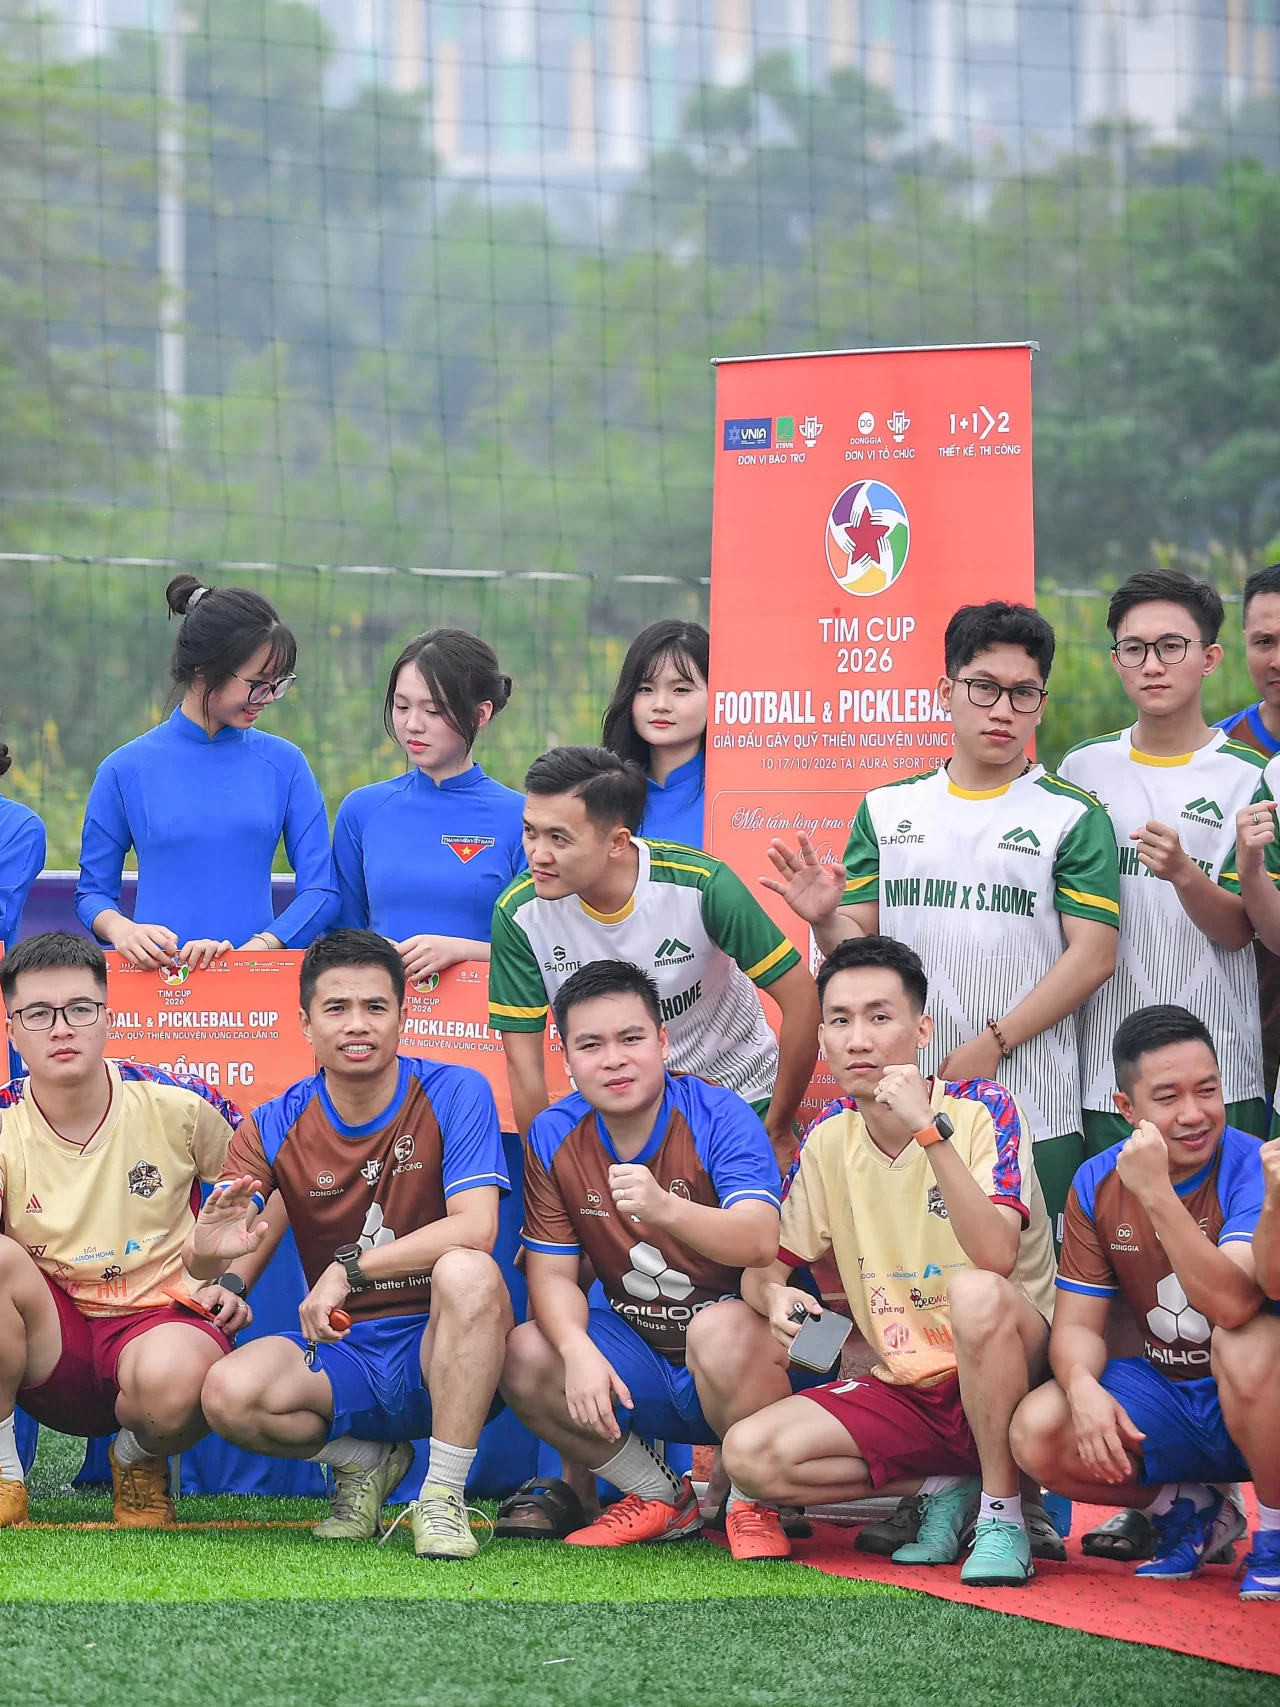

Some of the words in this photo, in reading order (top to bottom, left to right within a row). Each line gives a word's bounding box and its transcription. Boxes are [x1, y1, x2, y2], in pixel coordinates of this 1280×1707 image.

[980, 445, 992, 456] THI
[994, 443, 1022, 456] CÔNG
[818, 617, 859, 643] TIM
[866, 616, 916, 642] CUP
[837, 648, 894, 673] 2026
[714, 690, 816, 725] FOOTBALL
[822, 700, 833, 723] &
[713, 732, 735, 748] GIẢI
[738, 729, 762, 748] ĐẤU
[766, 731, 790, 748] GÂY
[794, 730, 818, 749] QUỸ
[822, 730, 856, 750] THIỆN
[859, 730, 913, 750] NGUYỆN
[917, 730, 948, 747] VÙNG
[841, 757, 856, 771] TẠI
[859, 757, 889, 769] AURA
[892, 757, 928, 769] SPORT
[821, 815, 844, 829] trao
[880, 834, 926, 845] S.HOME
[924, 878, 958, 909] ANH
[976, 882, 1038, 918] S.HOME
[157, 990, 173, 998] TIM
[405, 996, 421, 1005] TIM
[423, 997, 440, 1006] CUP
[412, 1005, 432, 1013] 2026
[146, 1016, 154, 1028] &
[157, 1011, 245, 1028] PICKLEBALL
[248, 1011, 279, 1027] CUP
[147, 1030, 170, 1041] THIỆN
[173, 1030, 207, 1041] NGUYỆN
[209, 1030, 232, 1039] VÙNG
[233, 1031, 250, 1039] CAO
[270, 1031, 279, 1039] 10
[404, 1018, 490, 1040] PICKLEBALL
[417, 1039, 452, 1049] NGUYỆN
[453, 1040, 476, 1051] VÙNG
[477, 1043, 494, 1052] CAO
[227, 1061, 255, 1086] FC
[319, 1175, 333, 1184] DG
[309, 1187, 345, 1197] DONGGIA
[586, 1193, 600, 1203] DG
[580, 1208, 610, 1218] DONGGIA
[1117, 1228, 1131, 1238] DG
[1110, 1243, 1140, 1252] DONGGIA
[67, 1253, 95, 1263] MAISON
[95, 1249, 115, 1259] HOME
[374, 1279, 405, 1291] better
[408, 1275, 432, 1287] livin
[636, 1315, 667, 1332] house
